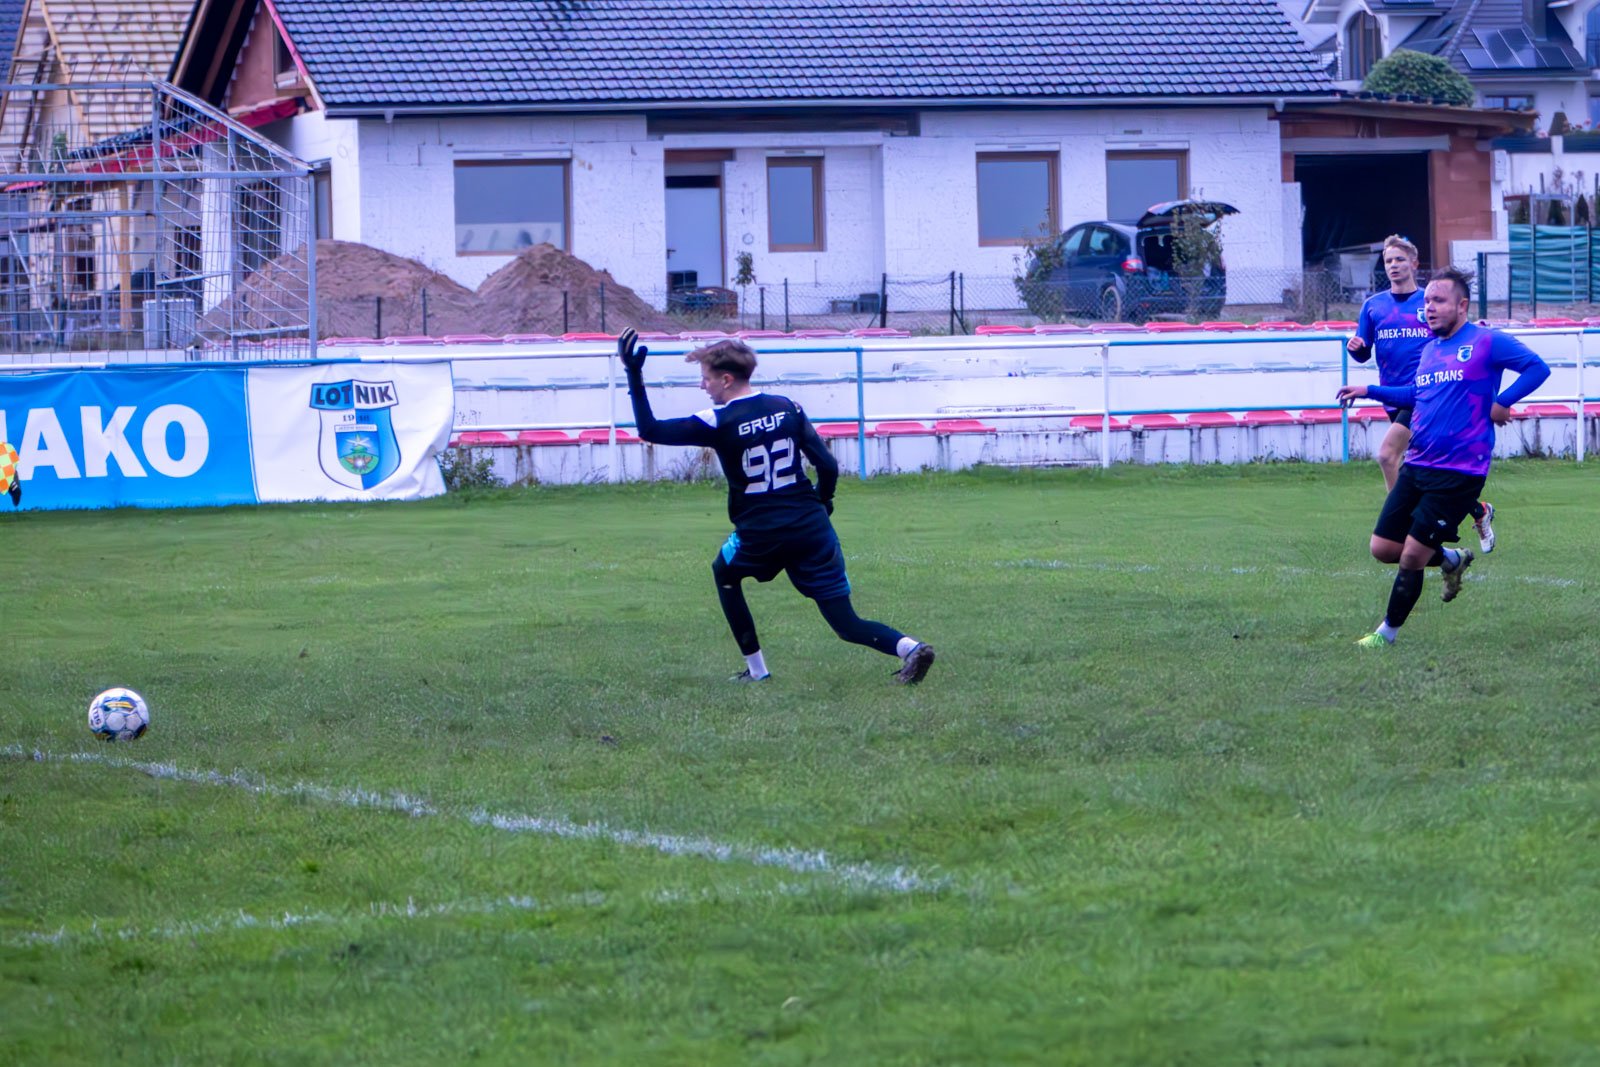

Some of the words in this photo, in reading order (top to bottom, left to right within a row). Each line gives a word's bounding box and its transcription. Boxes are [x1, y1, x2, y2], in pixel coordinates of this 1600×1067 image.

[315, 385, 393, 405] LOTNIK
[0, 404, 210, 480] AKO
[738, 411, 785, 436] GRYF
[742, 437, 797, 494] 92
